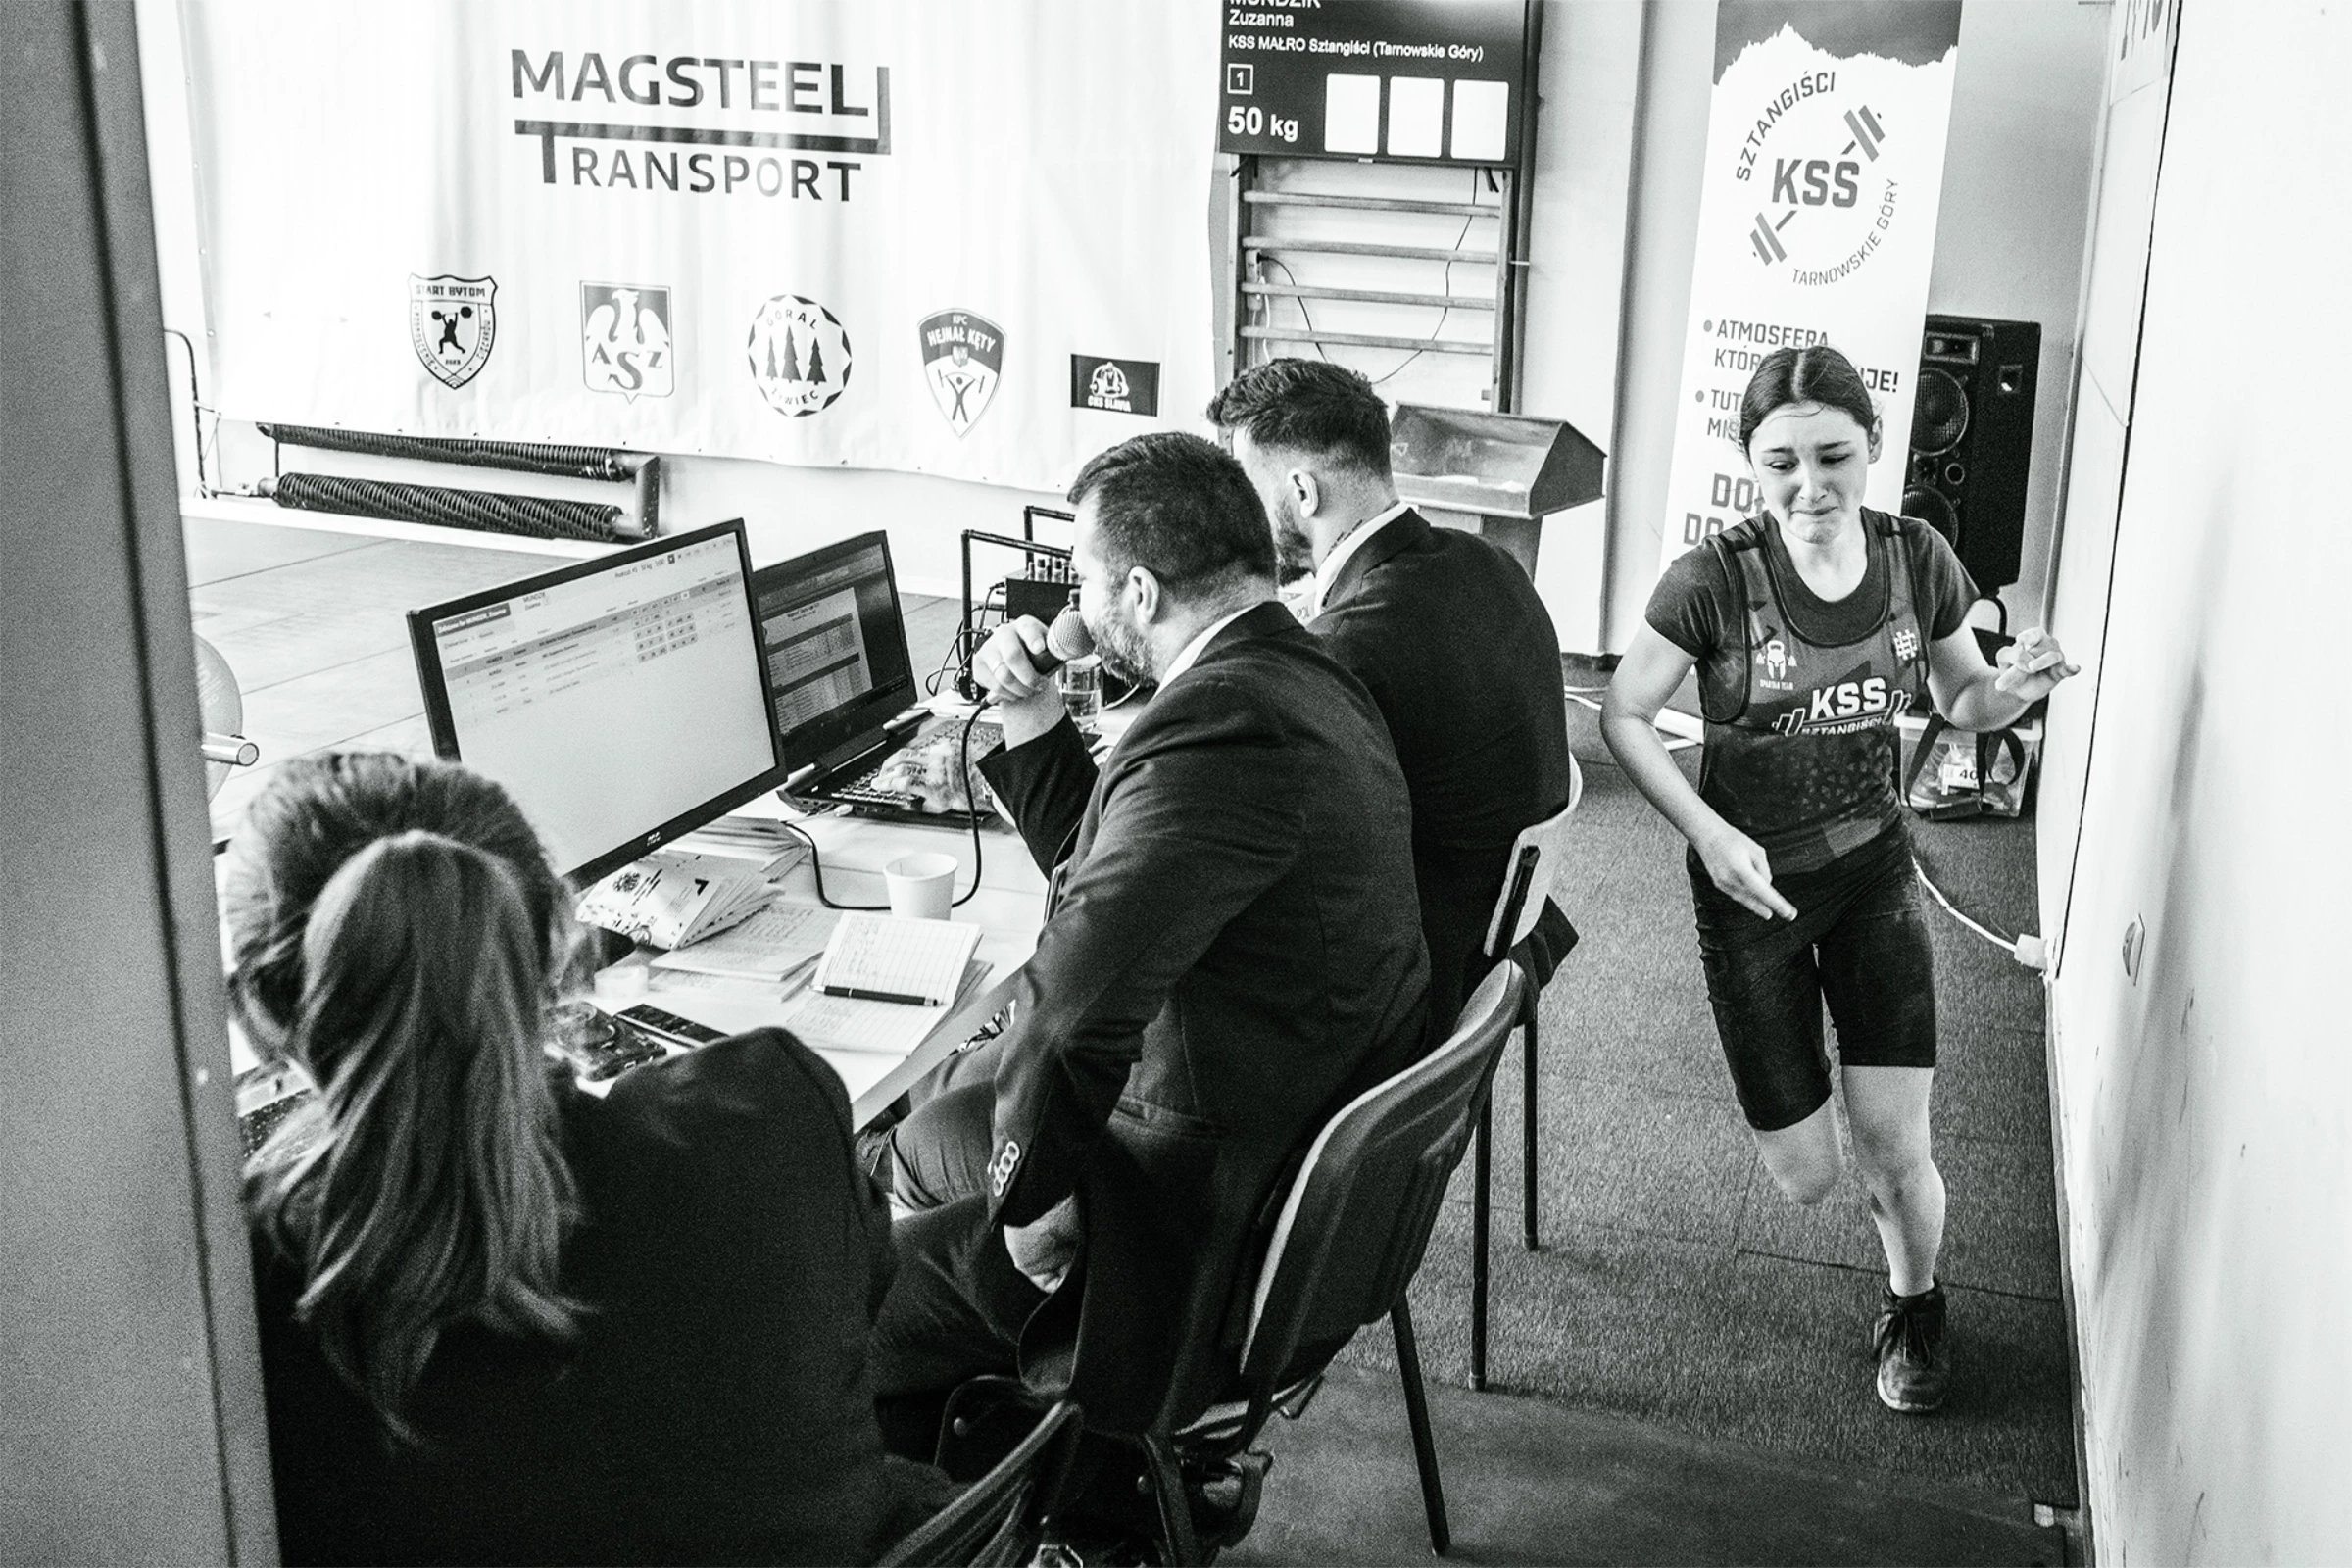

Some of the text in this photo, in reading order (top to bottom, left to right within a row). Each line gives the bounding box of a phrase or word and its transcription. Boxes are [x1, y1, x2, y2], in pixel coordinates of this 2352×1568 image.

[1228, 9, 1294, 27] Zuzanna
[1228, 34, 1255, 50] KSS
[1258, 36, 1306, 52] MAŁRO
[1372, 40, 1446, 59] (Tarnowskie
[1448, 43, 1484, 63] Góry)
[511, 48, 869, 118] MAGSTEEL
[1237, 71, 1244, 87] 1
[1228, 105, 1298, 143] 50 kg
[1736, 71, 1837, 182] SZTANGIŚCI
[514, 119, 862, 202] TRANSPORT
[1792, 178, 1899, 287] TARNOWSKIE GÓRY
[1716, 318, 1829, 348] ATMOSFERA
[1714, 344, 1762, 371] KTÓR
[1711, 388, 1742, 412] TUT
[1810, 677, 1887, 721] KSS
